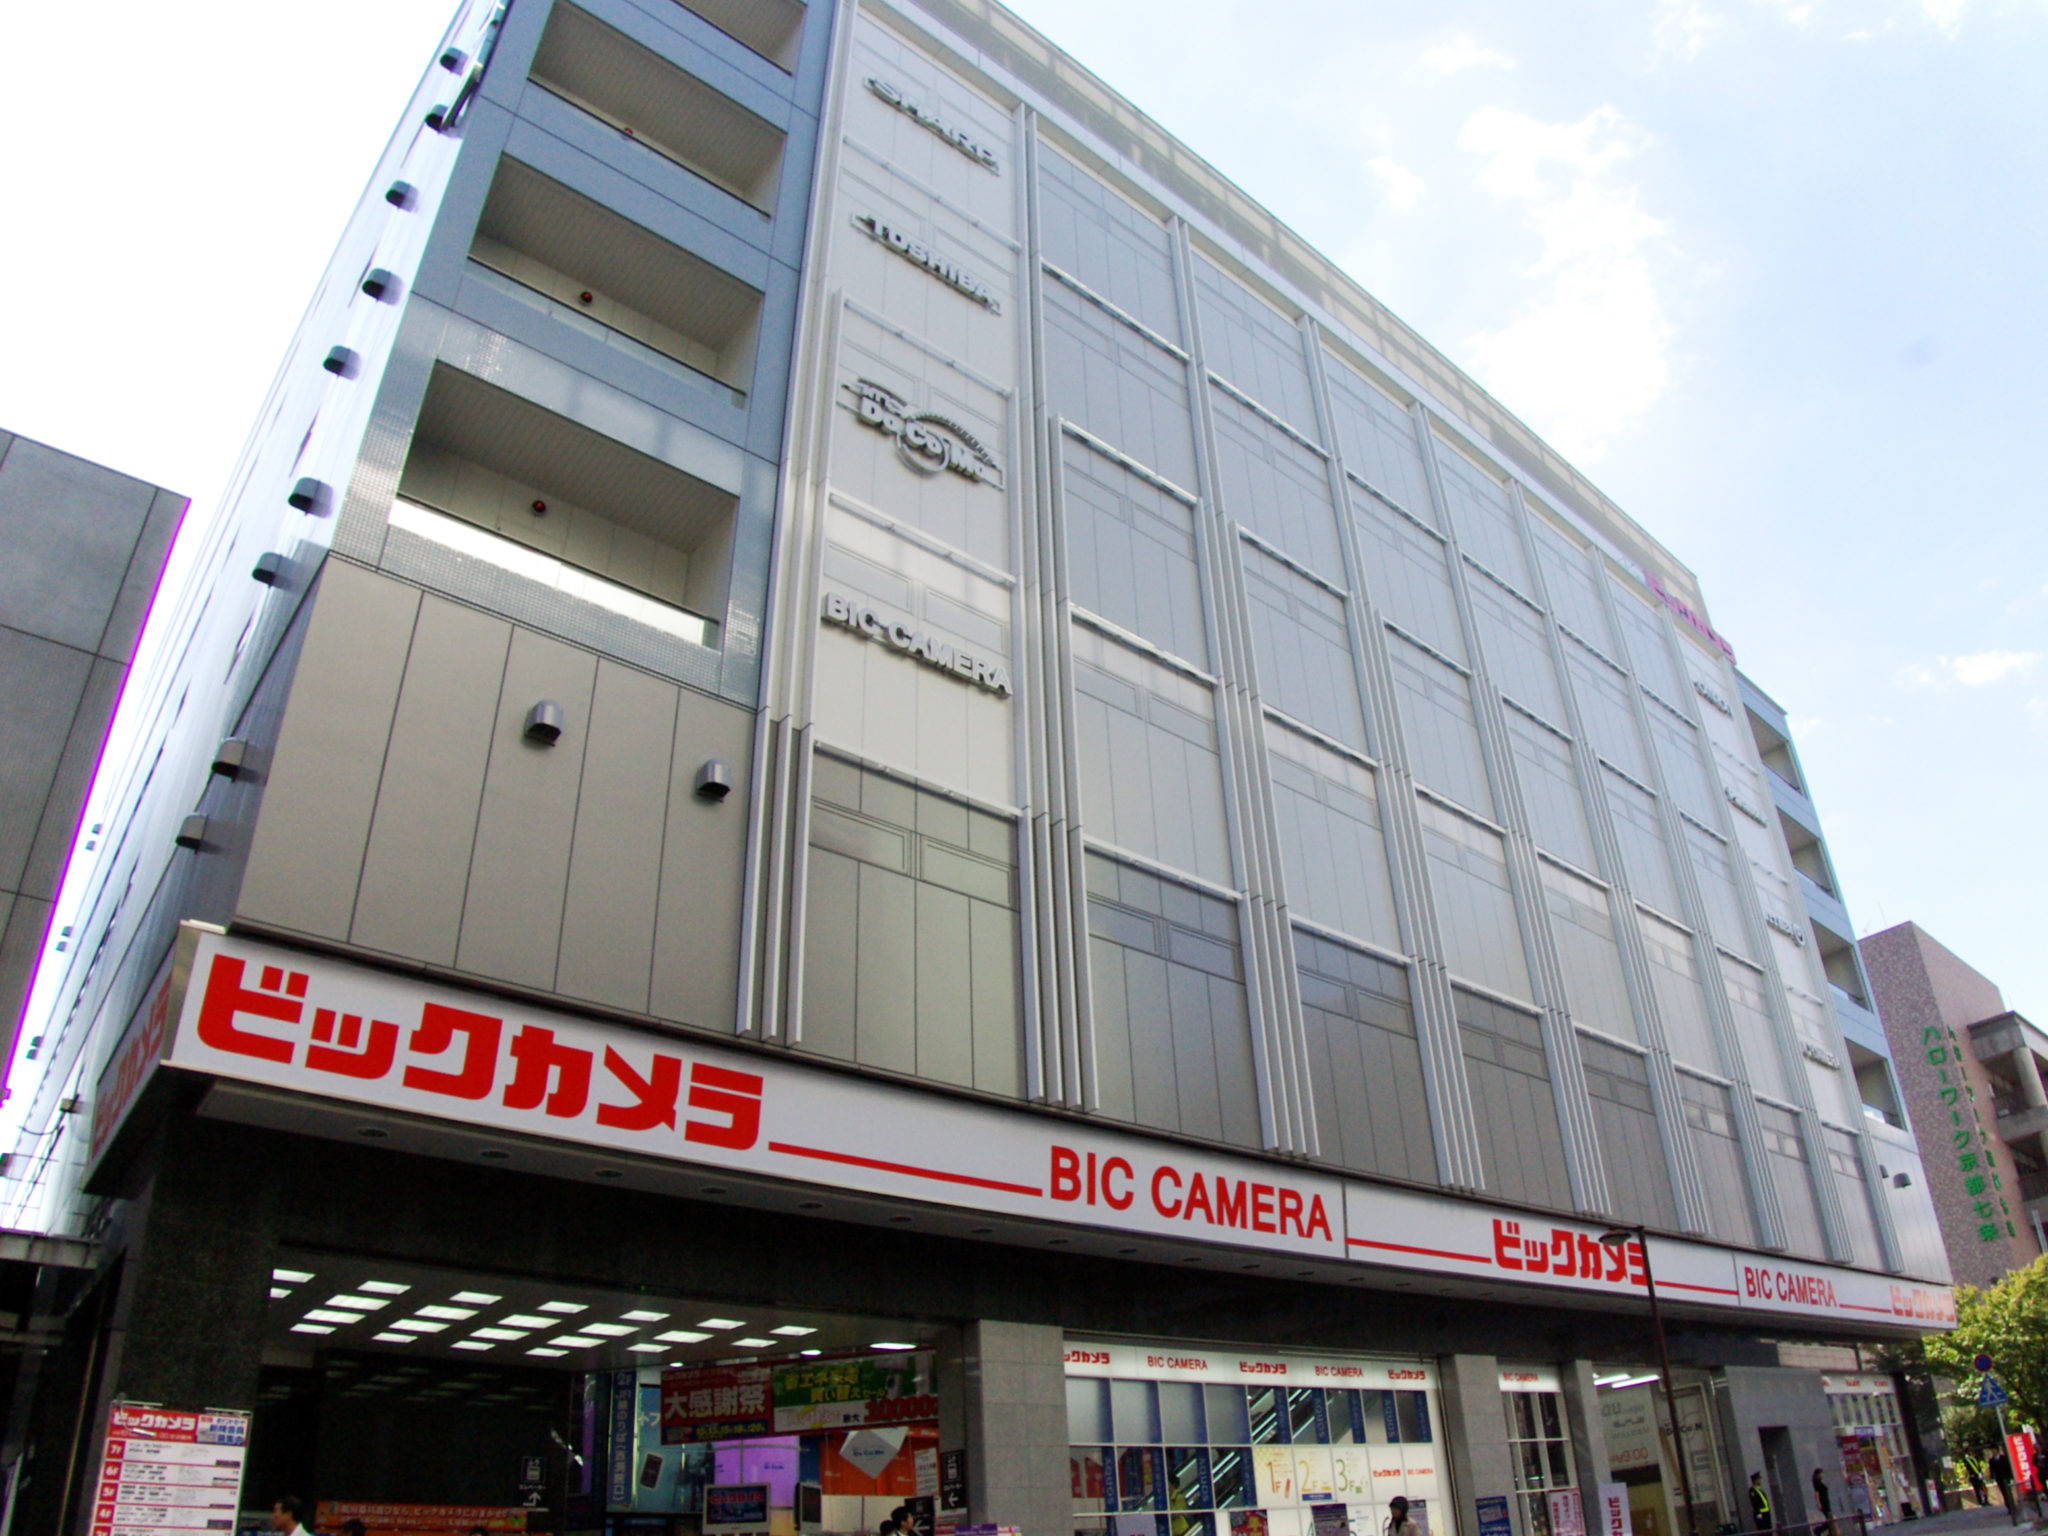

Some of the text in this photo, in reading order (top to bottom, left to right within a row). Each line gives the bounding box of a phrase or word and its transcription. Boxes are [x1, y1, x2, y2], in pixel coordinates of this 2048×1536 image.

[851, 214, 1002, 316] TOSHIBA
[822, 592, 1014, 696] BIC CAMERA
[197, 954, 763, 1151] ビックカメラ
[1050, 1145, 1333, 1242] BIC CAMERA
[1492, 1218, 1650, 1287] ビックカメラ
[1744, 1266, 1838, 1308] BIC CAMERA
[1147, 1356, 1209, 1371] BIC CAMERA
[1239, 1361, 1287, 1375] ビックカメラ
[1314, 1365, 1364, 1378] BIC CAMERA
[113, 1411, 196, 1431] ビックカメラ
[664, 1383, 767, 1421] 大感謝祭
